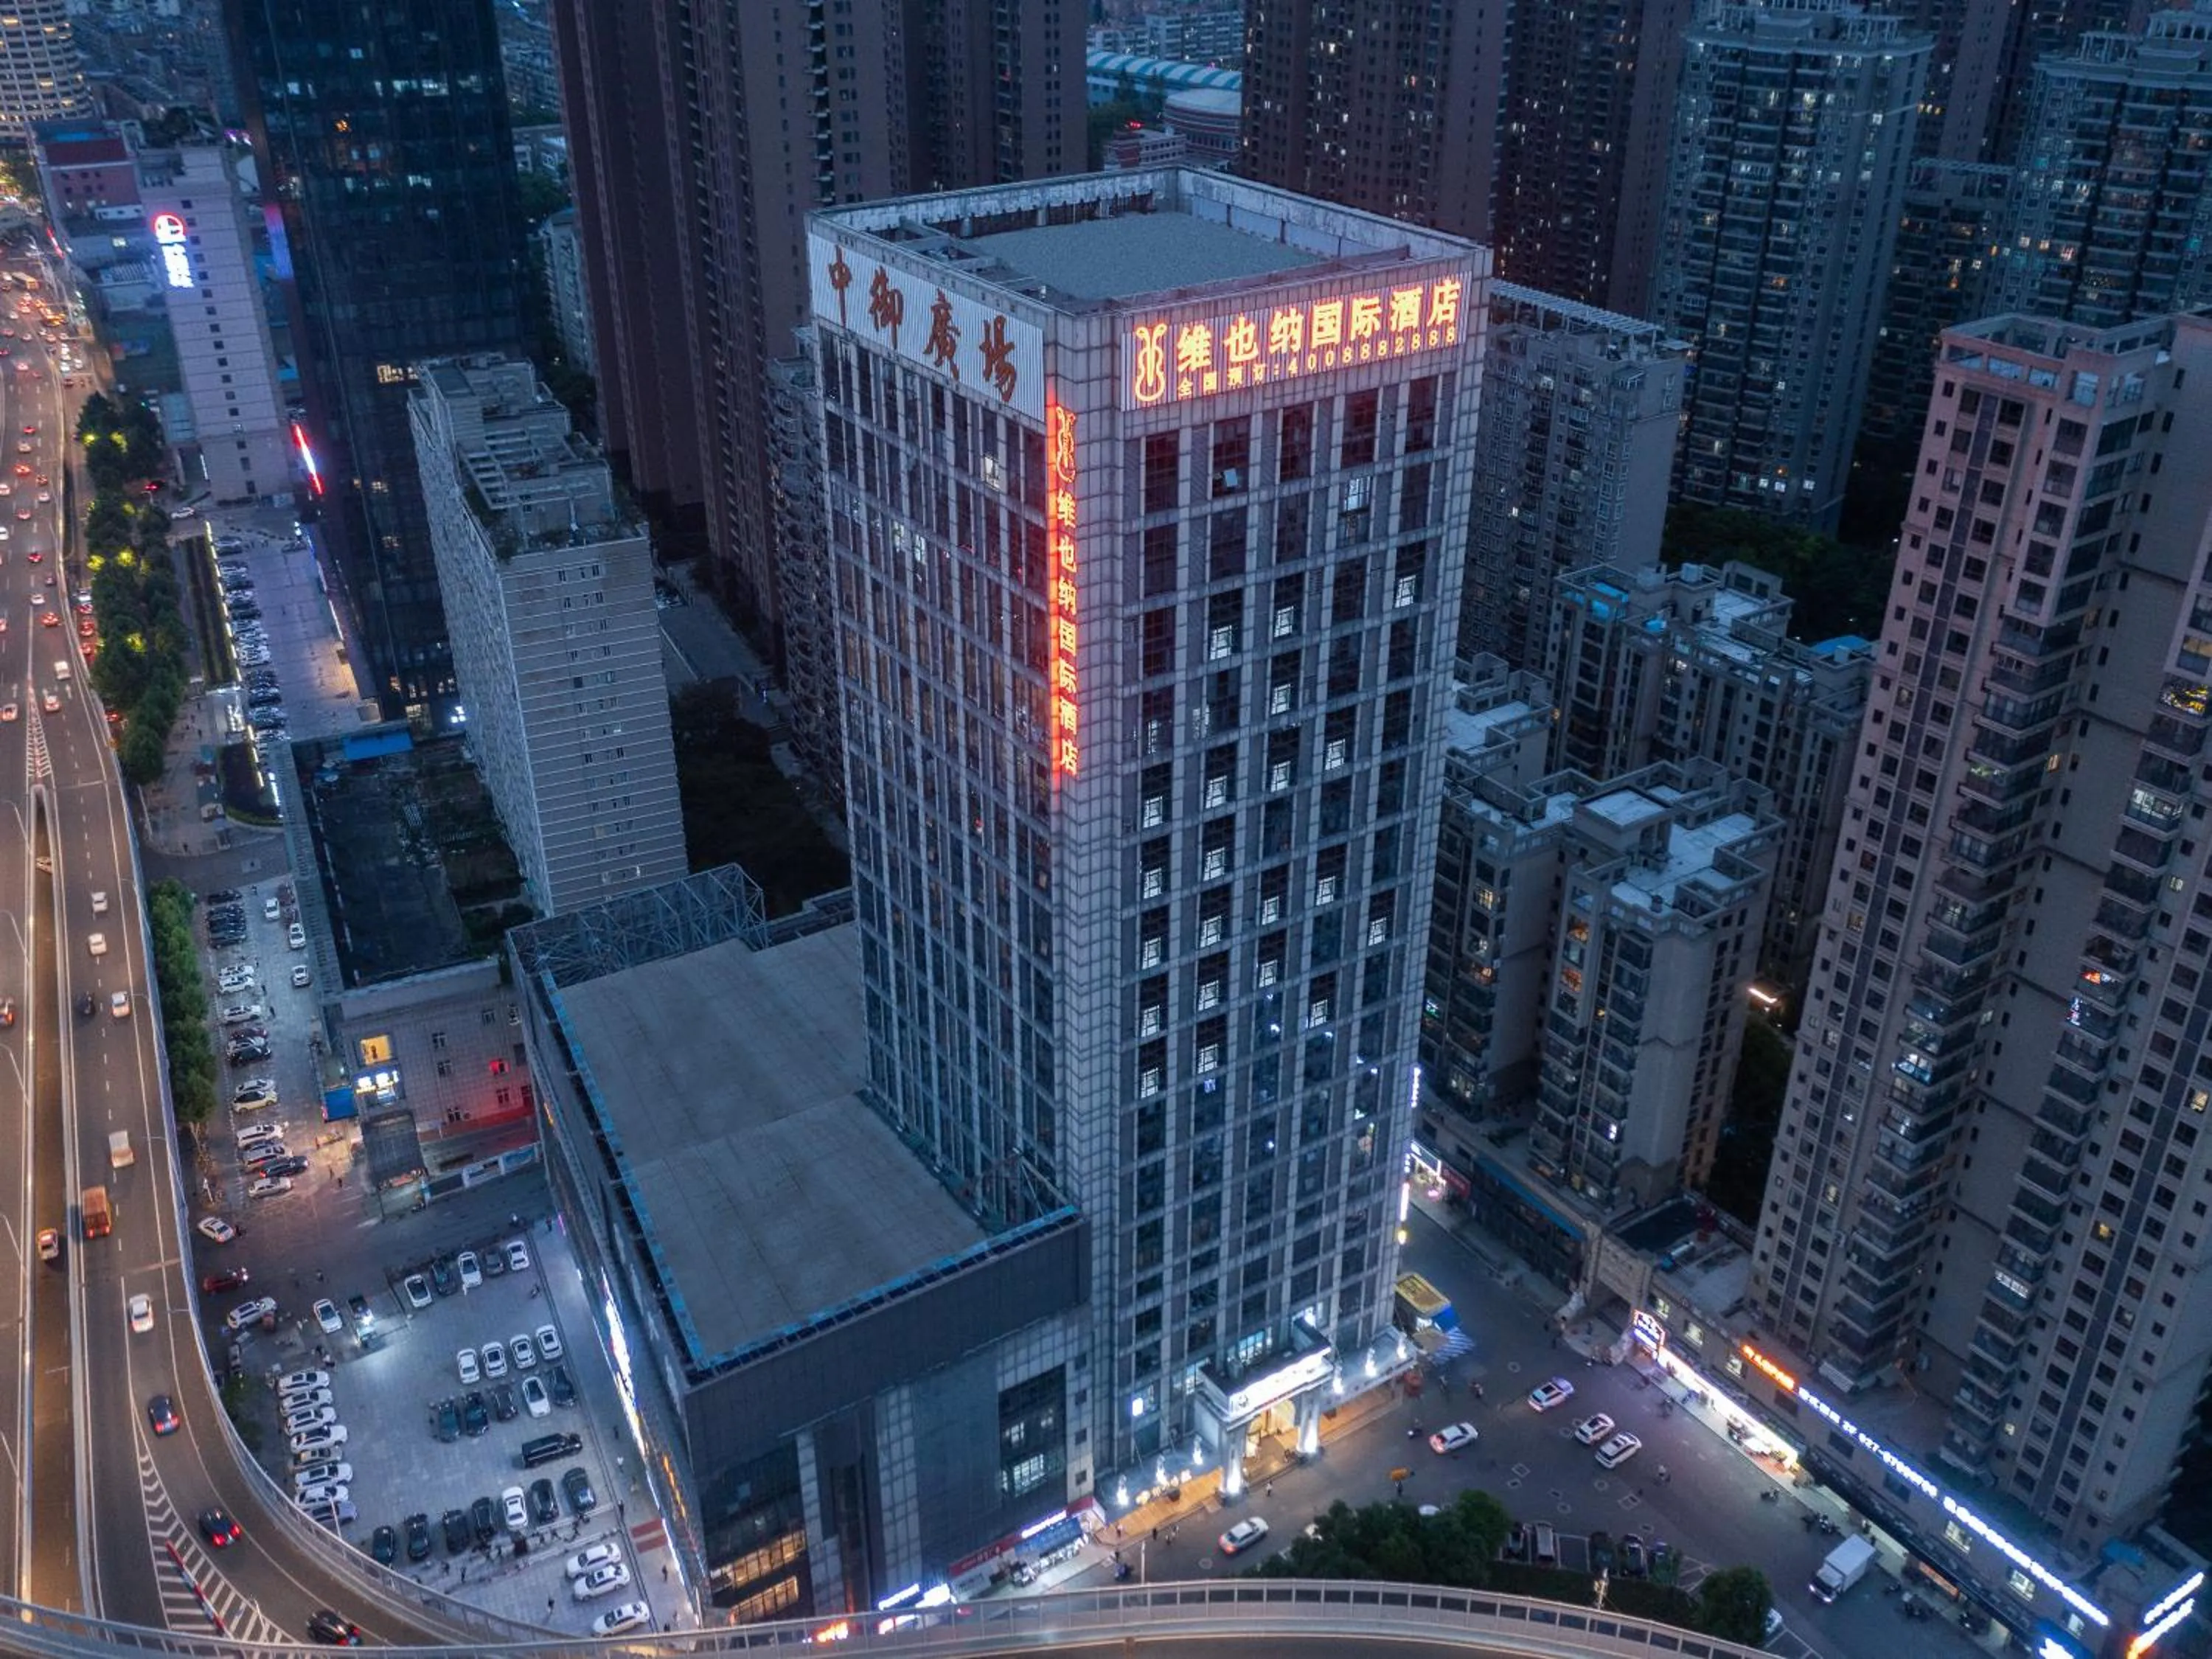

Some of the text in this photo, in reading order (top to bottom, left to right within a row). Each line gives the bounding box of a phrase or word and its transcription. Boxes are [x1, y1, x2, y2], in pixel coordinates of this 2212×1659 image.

[1177, 279, 1462, 373] 维也纳国际酒店
[1057, 489, 1078, 776] 维也纳国际酒店
